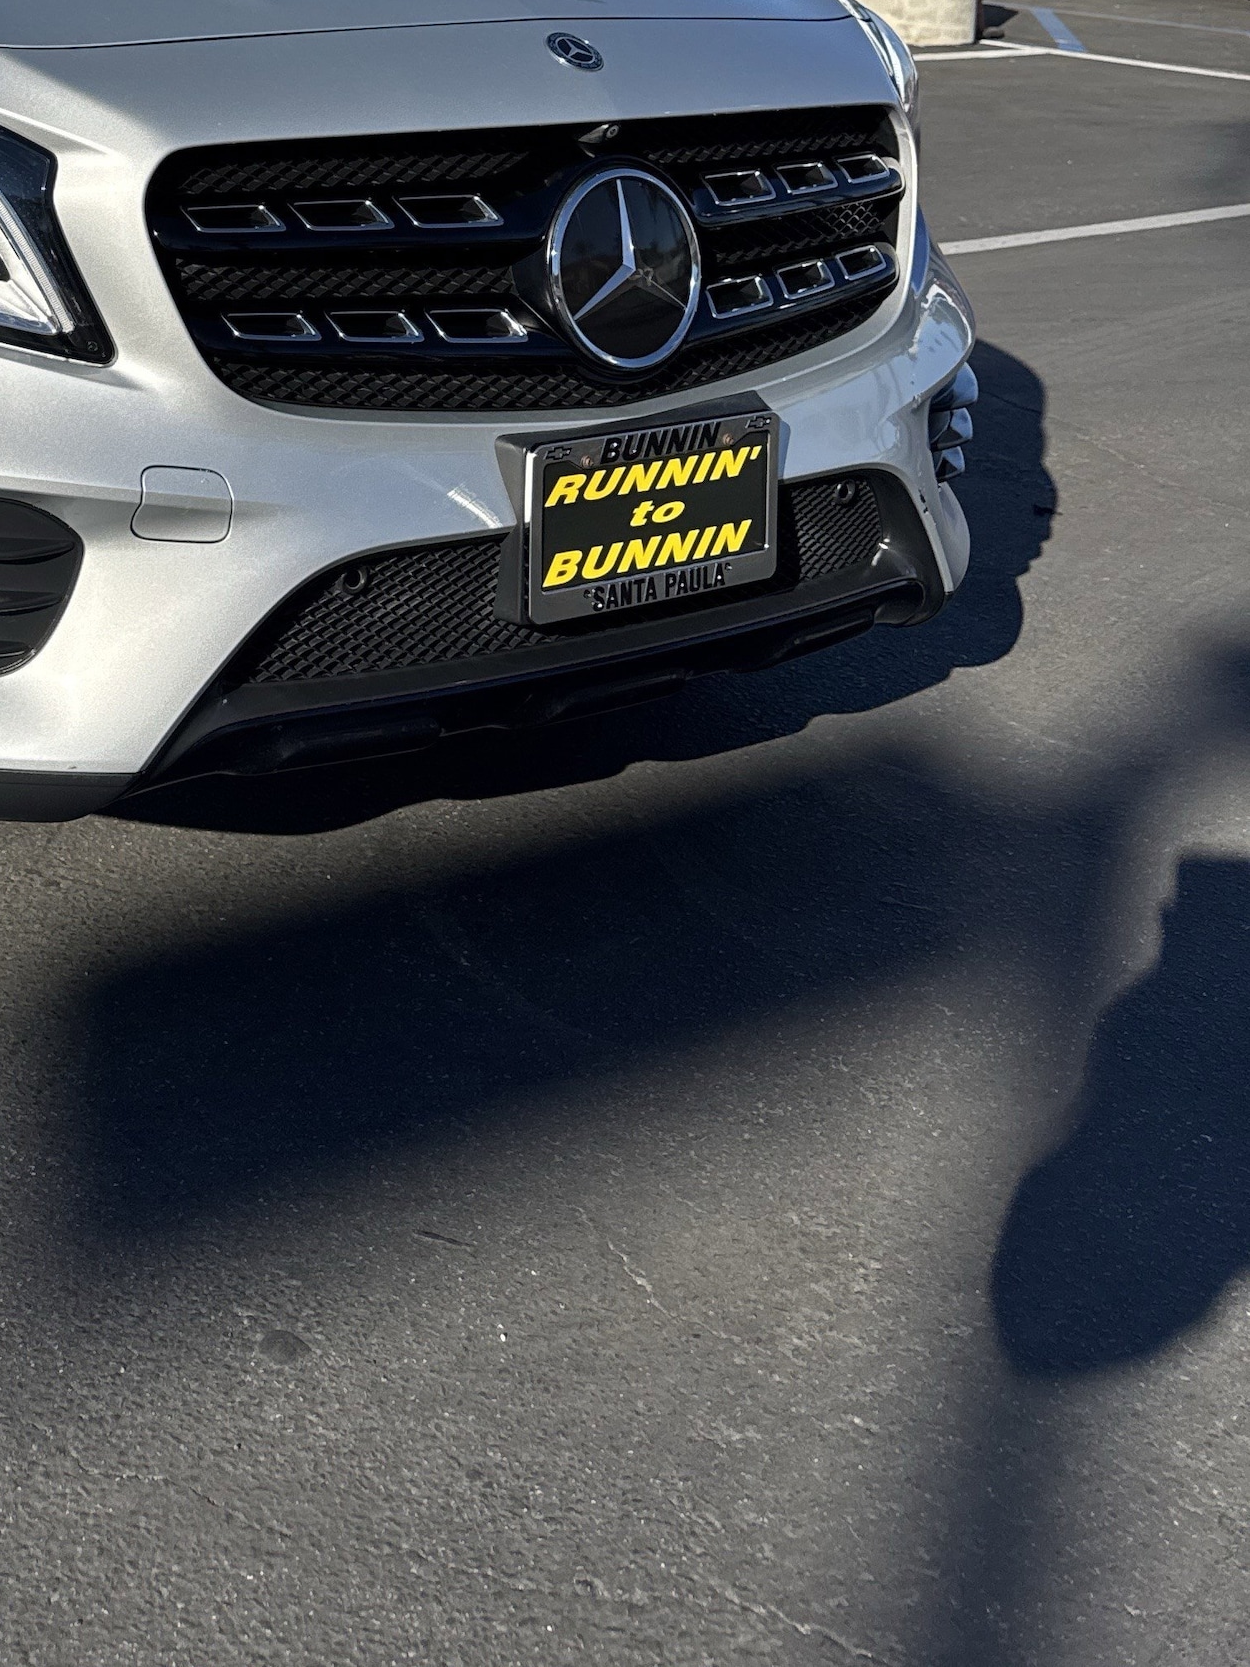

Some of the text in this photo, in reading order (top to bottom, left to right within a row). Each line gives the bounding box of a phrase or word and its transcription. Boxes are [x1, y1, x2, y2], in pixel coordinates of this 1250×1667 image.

[600, 421, 721, 464] BUNNIN
[545, 445, 762, 508] RUNNIN'
[630, 500, 686, 527] to
[542, 519, 752, 588] BUNNIN
